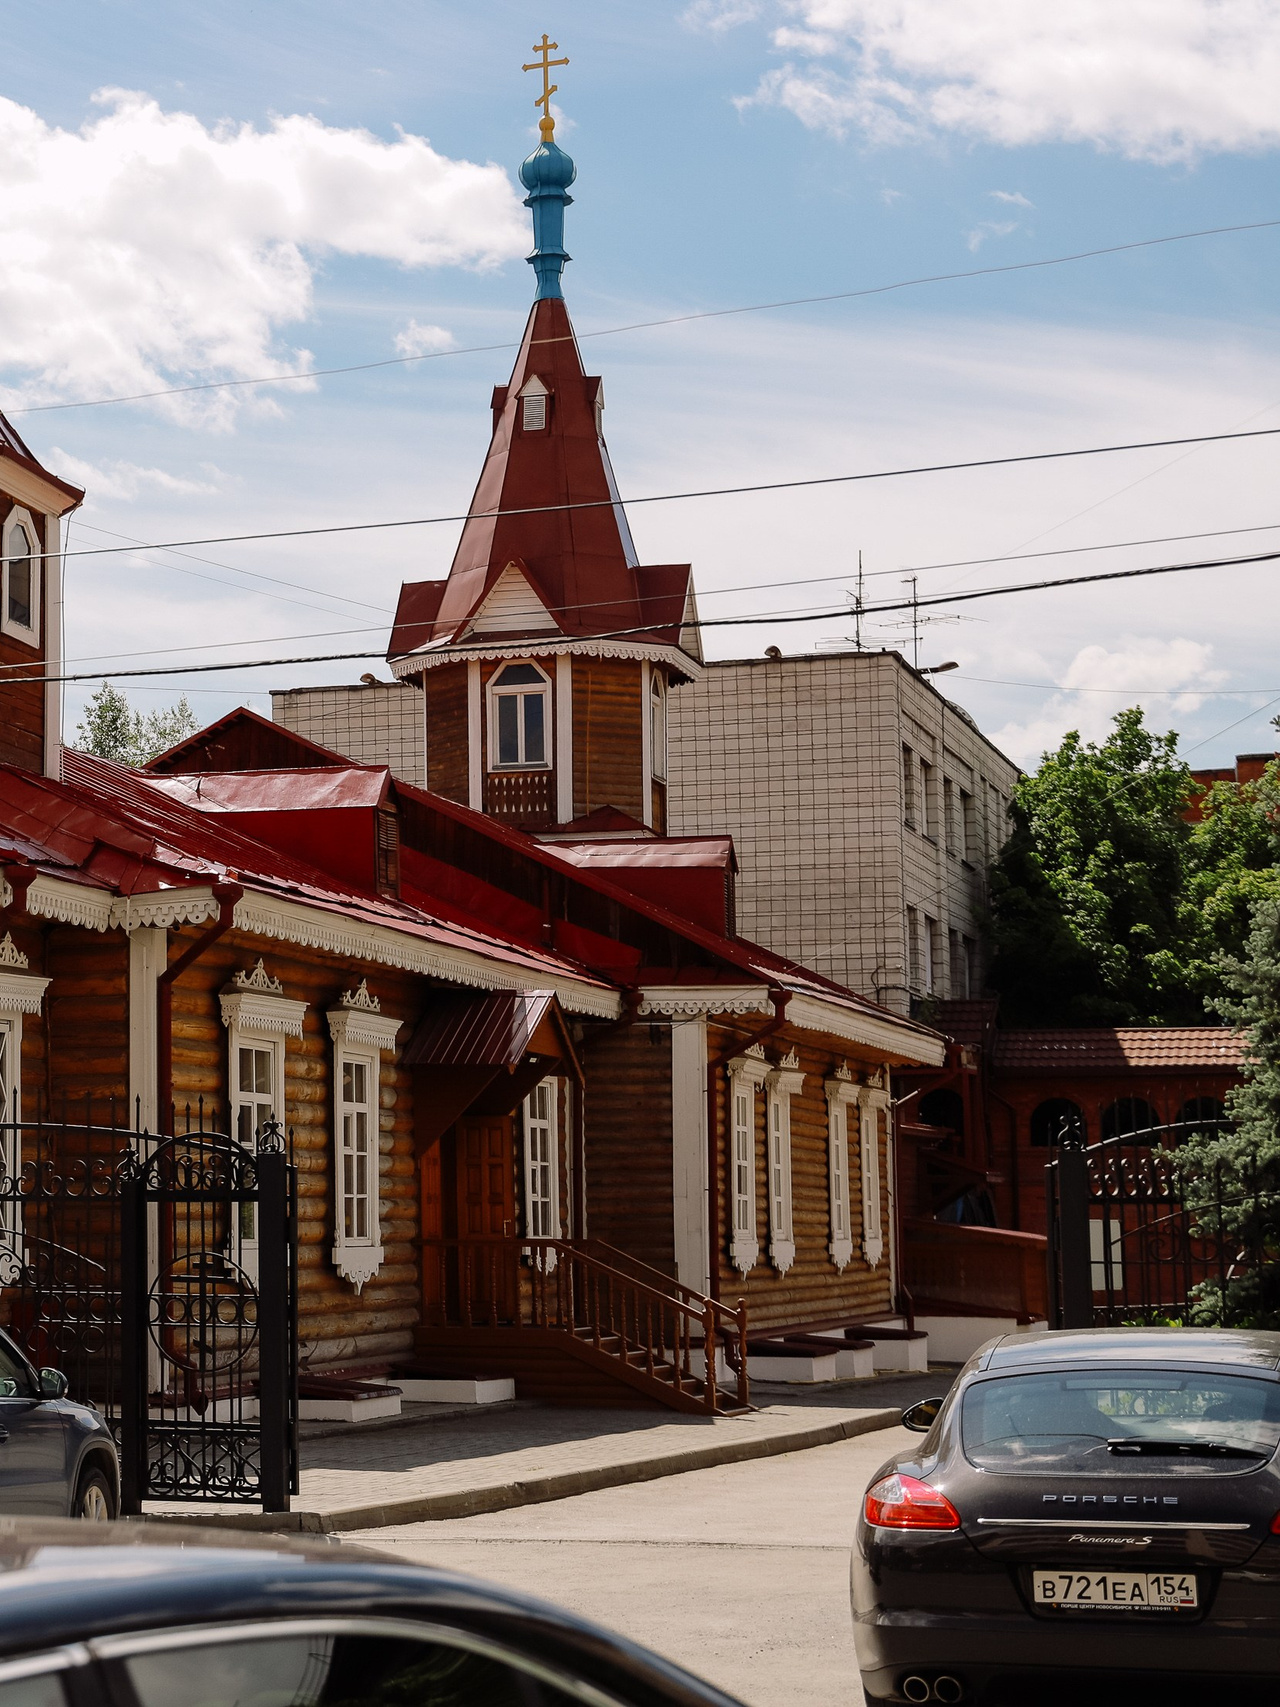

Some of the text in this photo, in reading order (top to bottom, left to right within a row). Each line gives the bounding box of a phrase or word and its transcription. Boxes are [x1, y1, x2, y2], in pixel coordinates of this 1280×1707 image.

[1042, 1494, 1179, 1505] PORSCHE
[1068, 1533, 1153, 1545] Panamera S
[1150, 1576, 1191, 1596] 154
[1159, 1595, 1179, 1604] RUS
